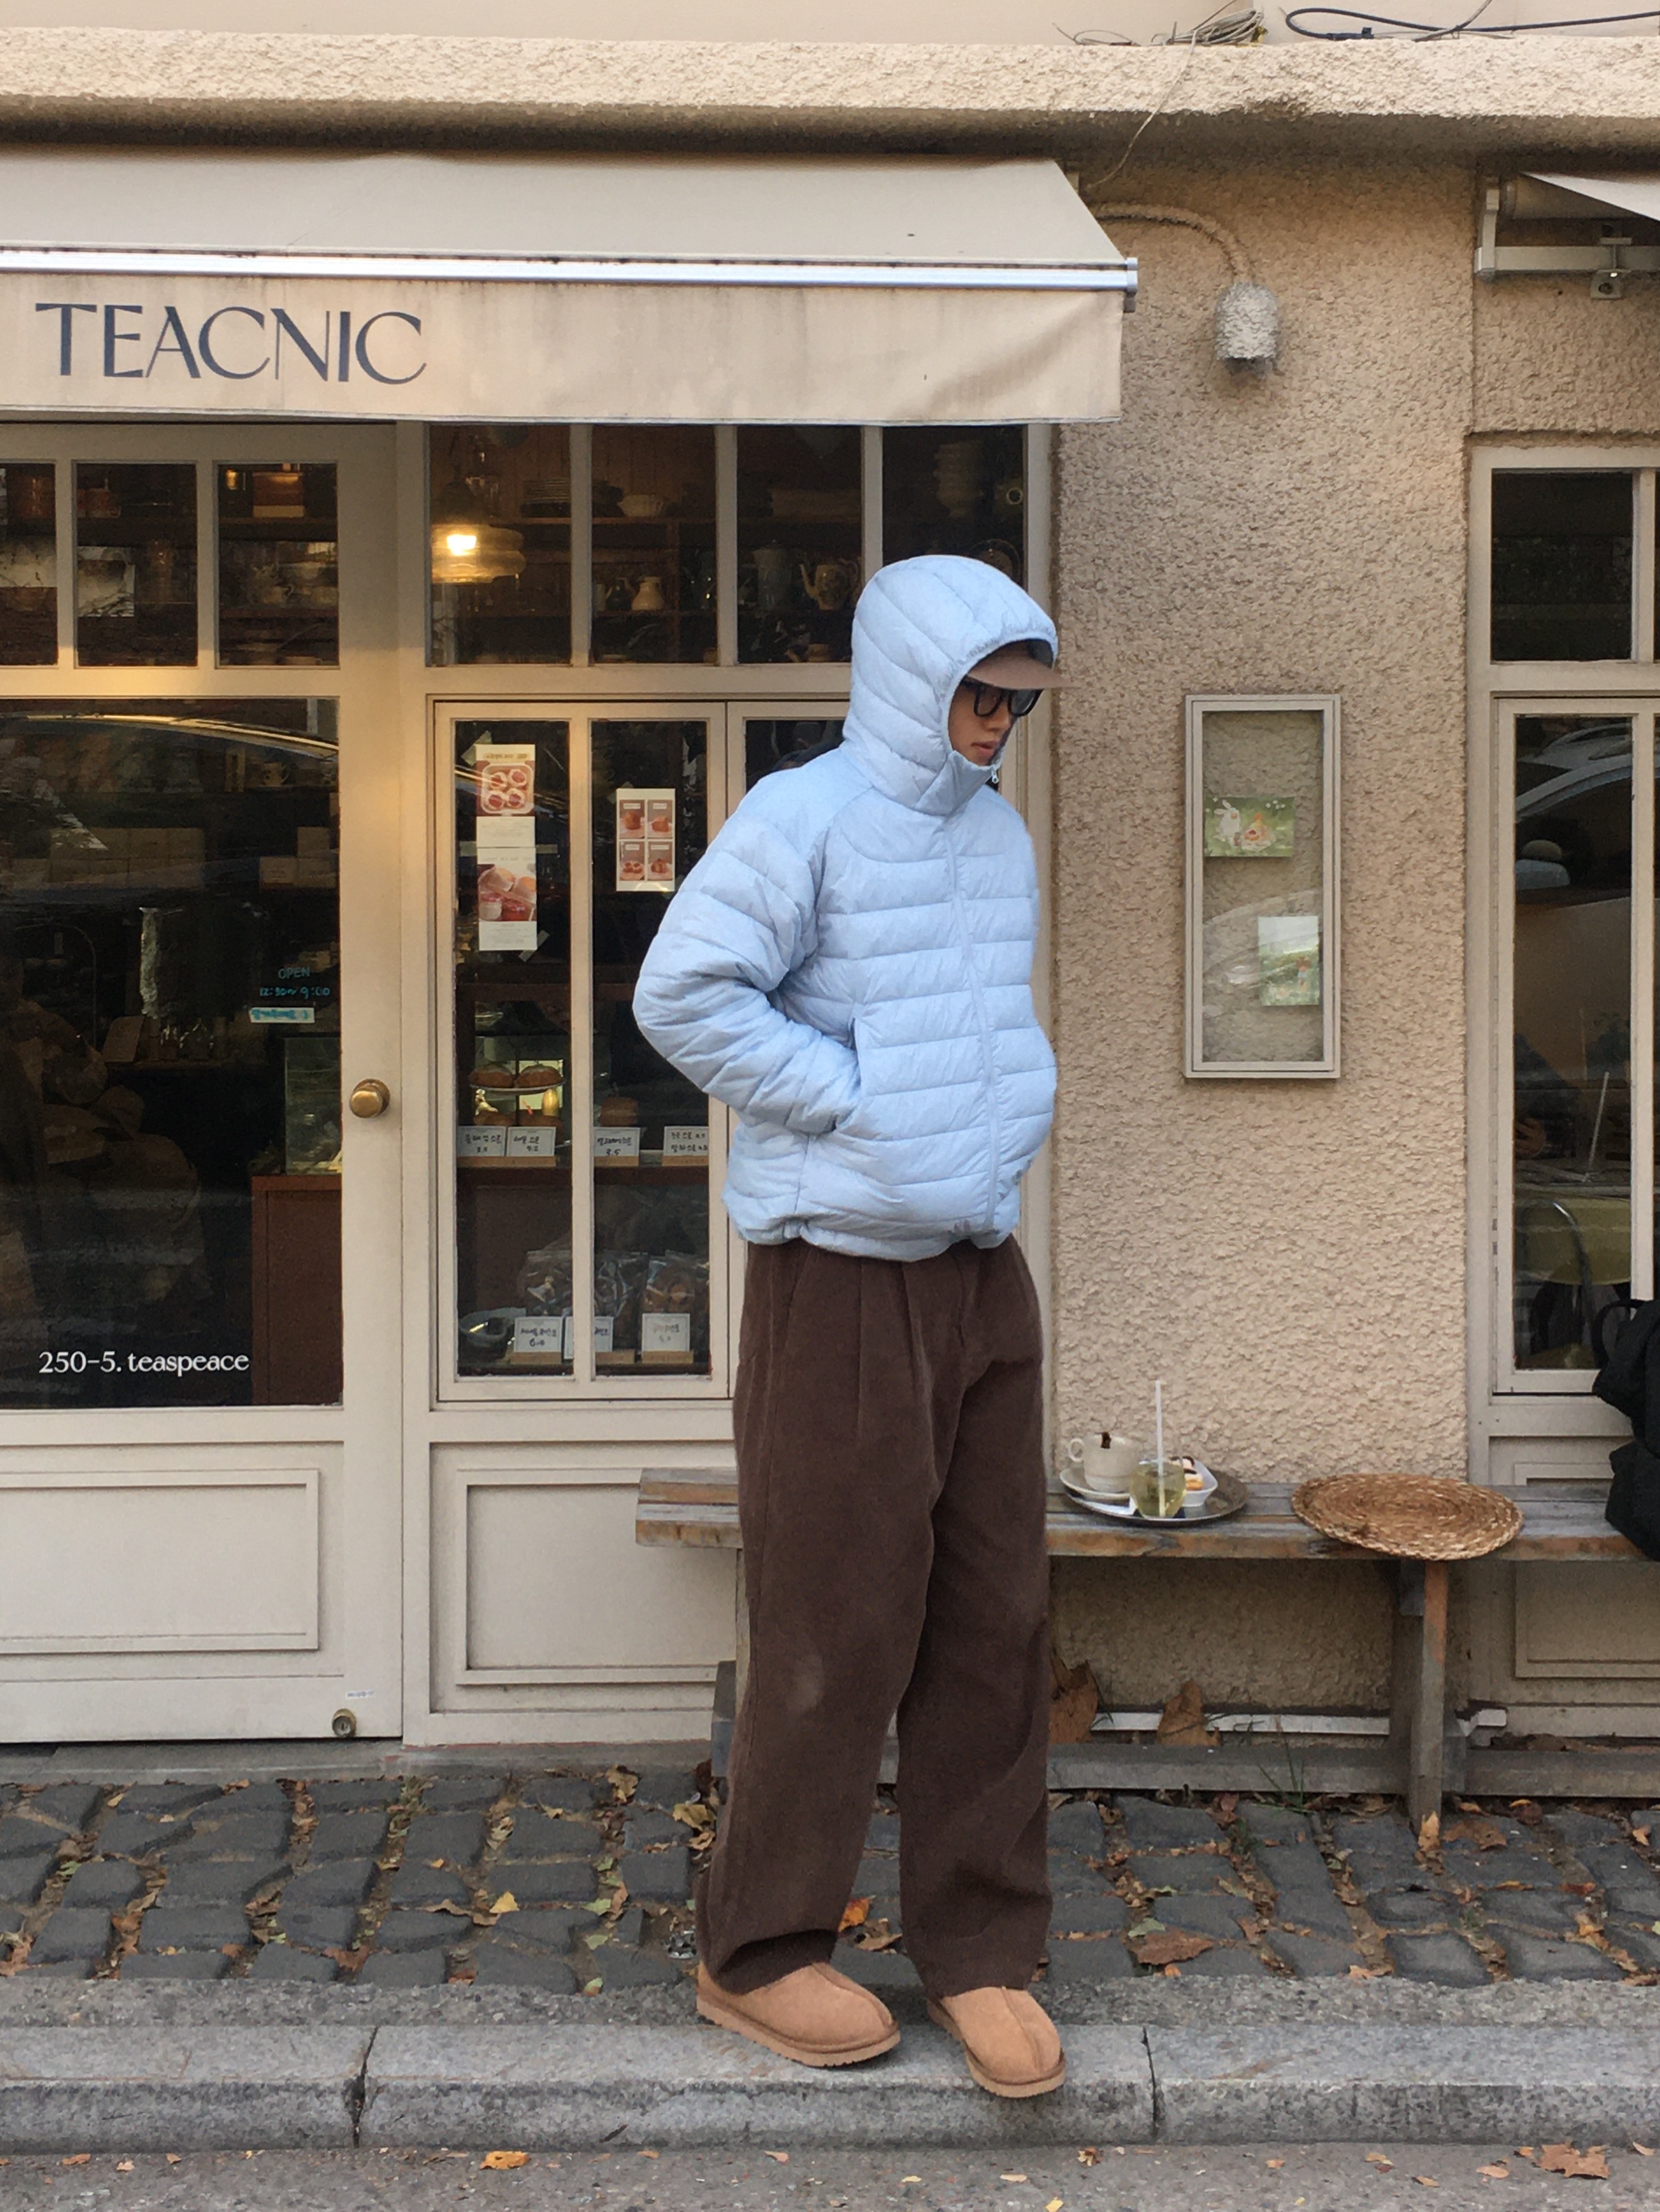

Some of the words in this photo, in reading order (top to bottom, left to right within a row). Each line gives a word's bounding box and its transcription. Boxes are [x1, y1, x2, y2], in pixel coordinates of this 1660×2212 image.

[36, 303, 427, 384] TEACNIC
[278, 967, 310, 979] OPEN
[38, 1351, 122, 1374] 250-5.
[127, 1352, 250, 1377] teaspeace
